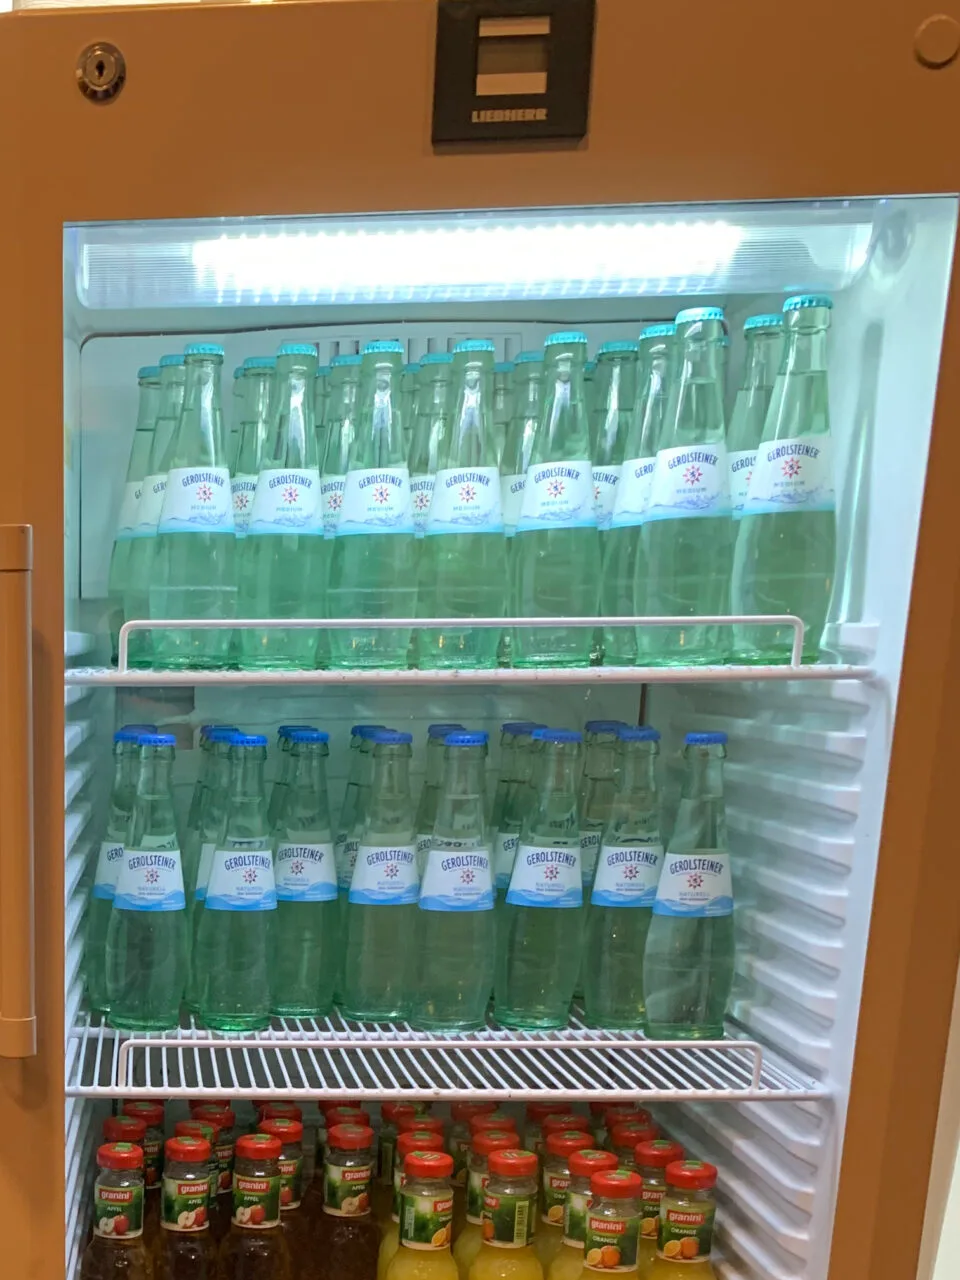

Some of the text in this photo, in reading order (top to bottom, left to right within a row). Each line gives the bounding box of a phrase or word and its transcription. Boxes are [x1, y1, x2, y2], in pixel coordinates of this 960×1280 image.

[471, 108, 548, 123] LIEBHERR
[667, 451, 719, 470] GEROLSTEINER
[766, 443, 820, 462] GEROLSTEINER
[181, 472, 225, 487] GEROLSTEINER
[268, 474, 313, 489] GEROLSTEINER
[358, 473, 404, 489] GEROLSTEINER
[445, 472, 492, 488] GEROLSTEINER
[533, 466, 581, 484] GEROLSTEINER
[128, 854, 177, 871] GEROLSTEINER
[224, 854, 272, 871] GEROLSTEINER
[278, 847, 325, 864] GEROLSTEINER
[366, 849, 414, 866] GEROLSTEINER
[441, 854, 489, 872] GEROLSTEINER
[526, 850, 577, 867] GEROLSTEINER
[606, 850, 659, 867] GEROLSTEINER
[669, 858, 724, 875] GEROLSTEINER
[180, 1183, 208, 1195] granini
[238, 1180, 268, 1190] granini
[100, 1191, 131, 1202] granini
[591, 1219, 623, 1232] granini
[669, 1213, 702, 1225] granini
[670, 1227, 697, 1235] ORANGE
[592, 1235, 618, 1244] ORANGE
